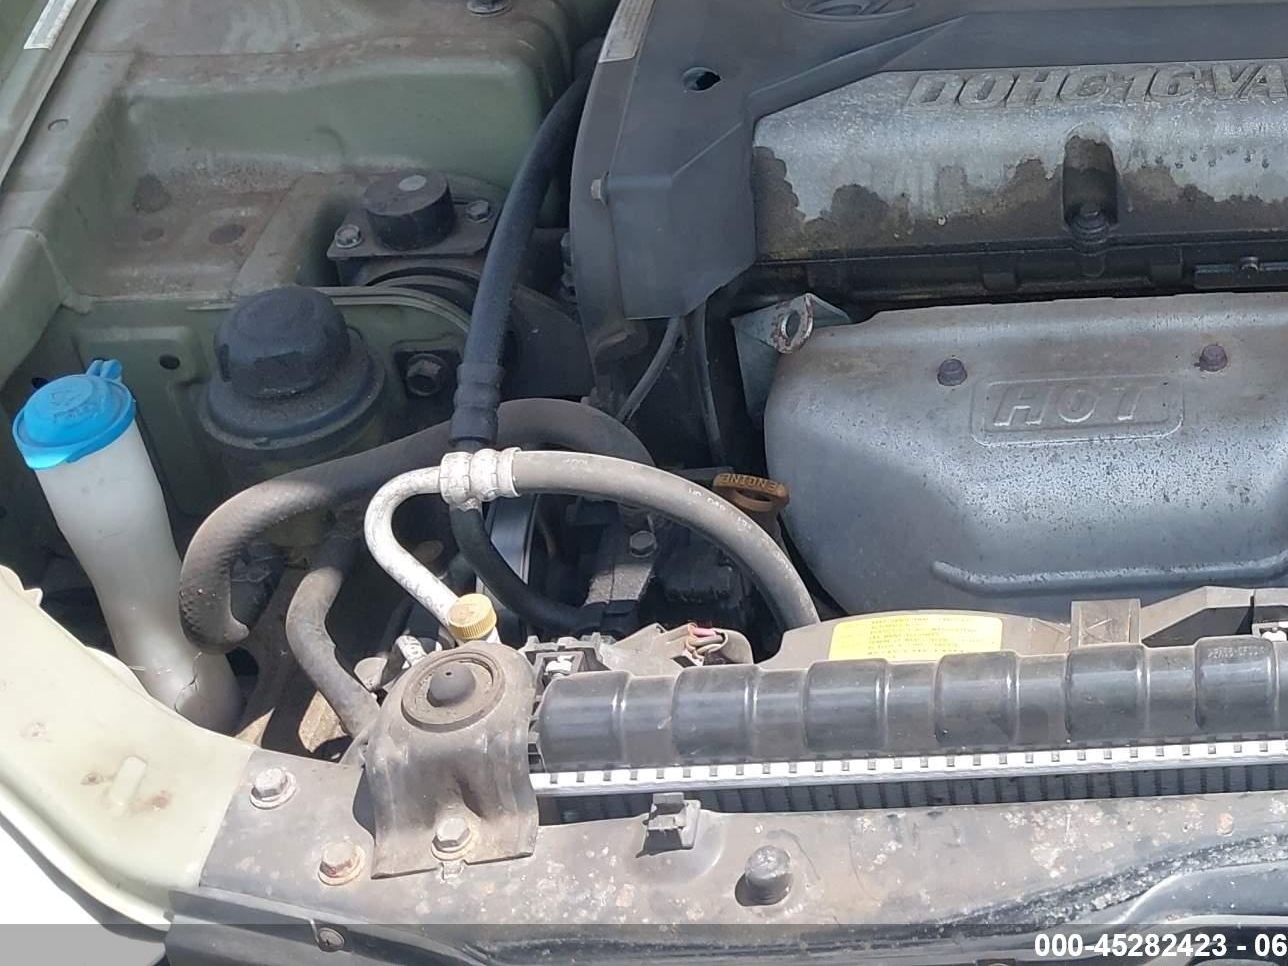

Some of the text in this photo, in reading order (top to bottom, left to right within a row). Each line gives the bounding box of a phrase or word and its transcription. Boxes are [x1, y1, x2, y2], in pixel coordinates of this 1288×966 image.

[905, 67, 1108, 109] DOHC
[993, 384, 1158, 428] HOT
[718, 473, 779, 492] ENGINE
